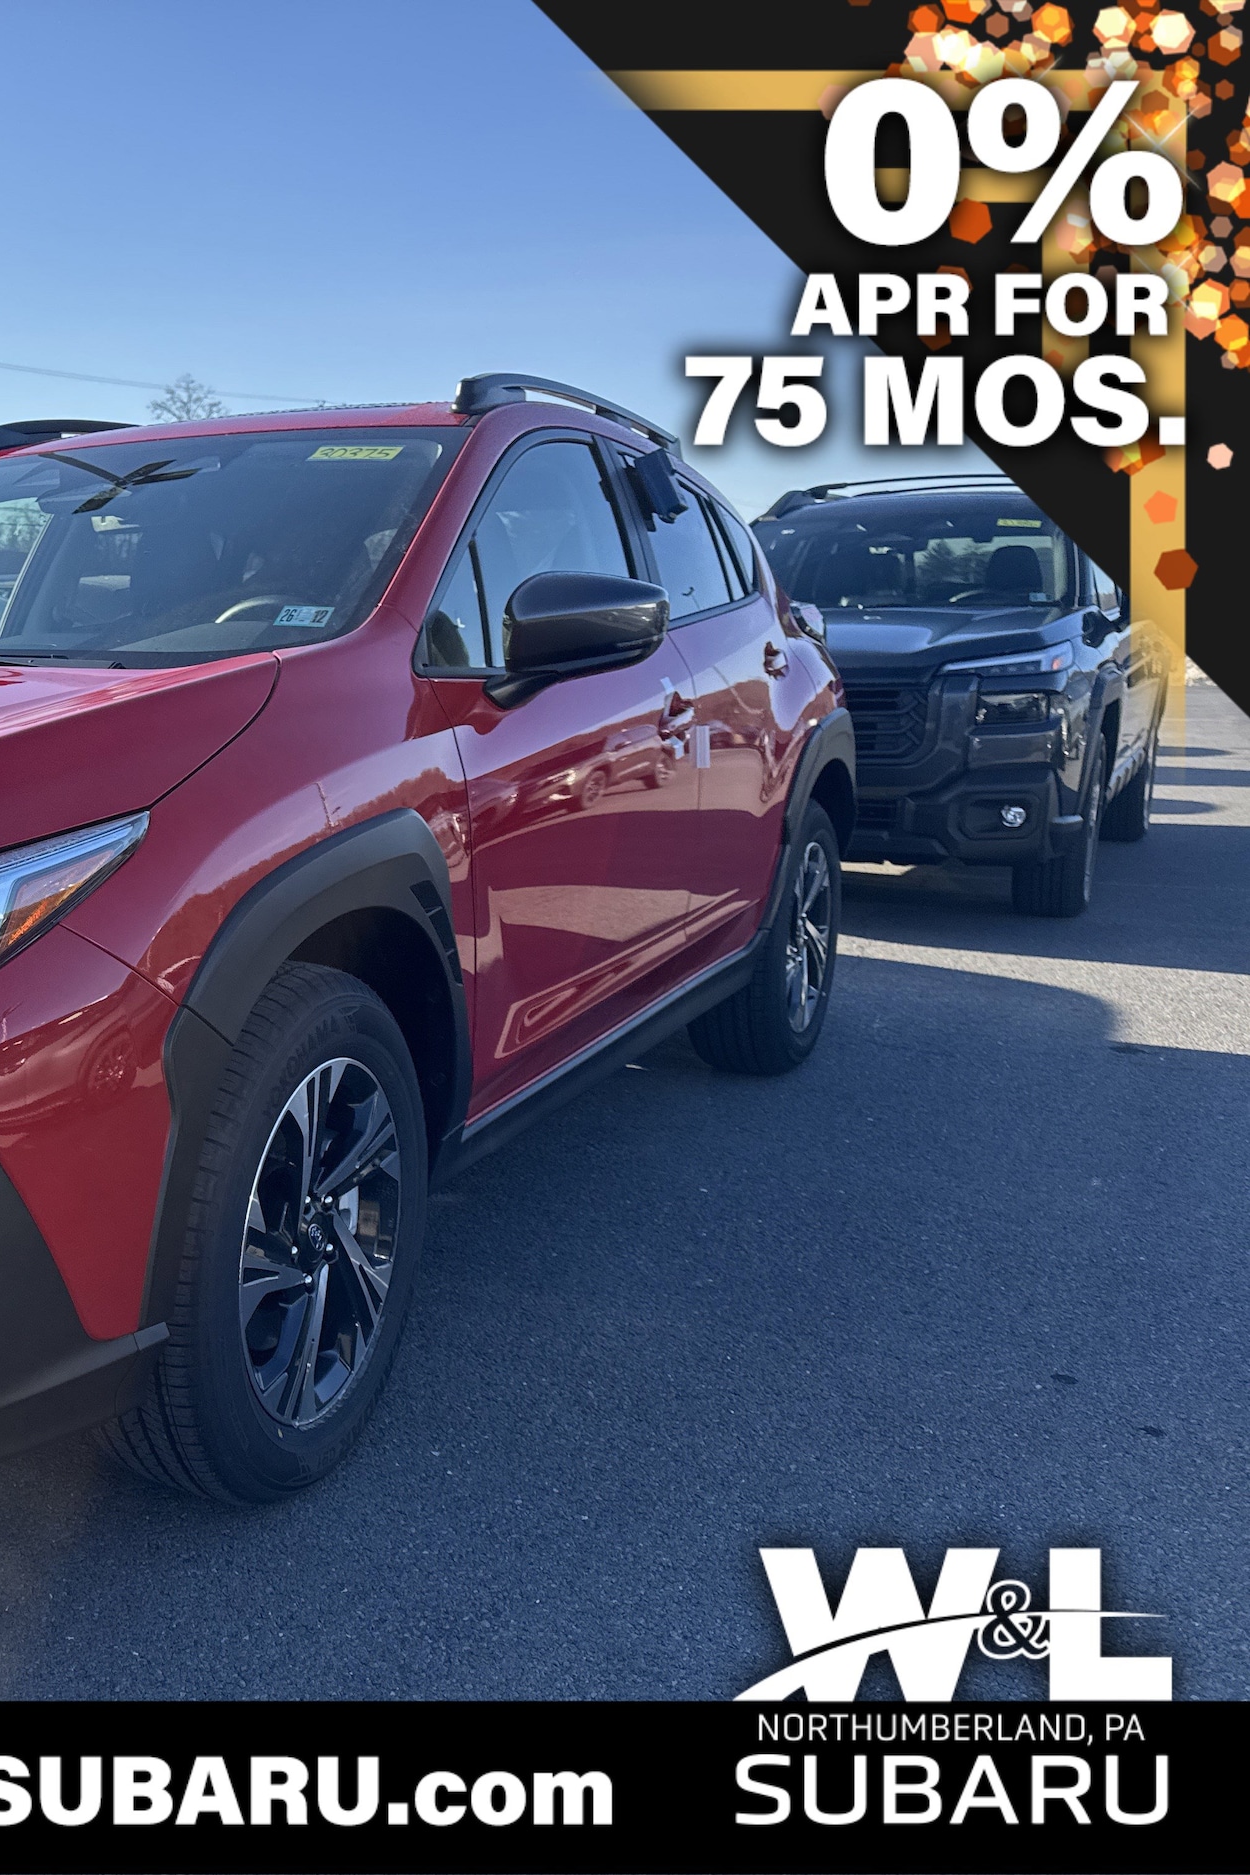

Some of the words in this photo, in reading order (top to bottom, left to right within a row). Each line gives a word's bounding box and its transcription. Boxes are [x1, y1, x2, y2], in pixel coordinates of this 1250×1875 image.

[312, 447, 396, 459] 30375
[279, 608, 298, 623] 26
[310, 609, 329, 624] 12
[261, 1014, 341, 1117] YOKOHAMA
